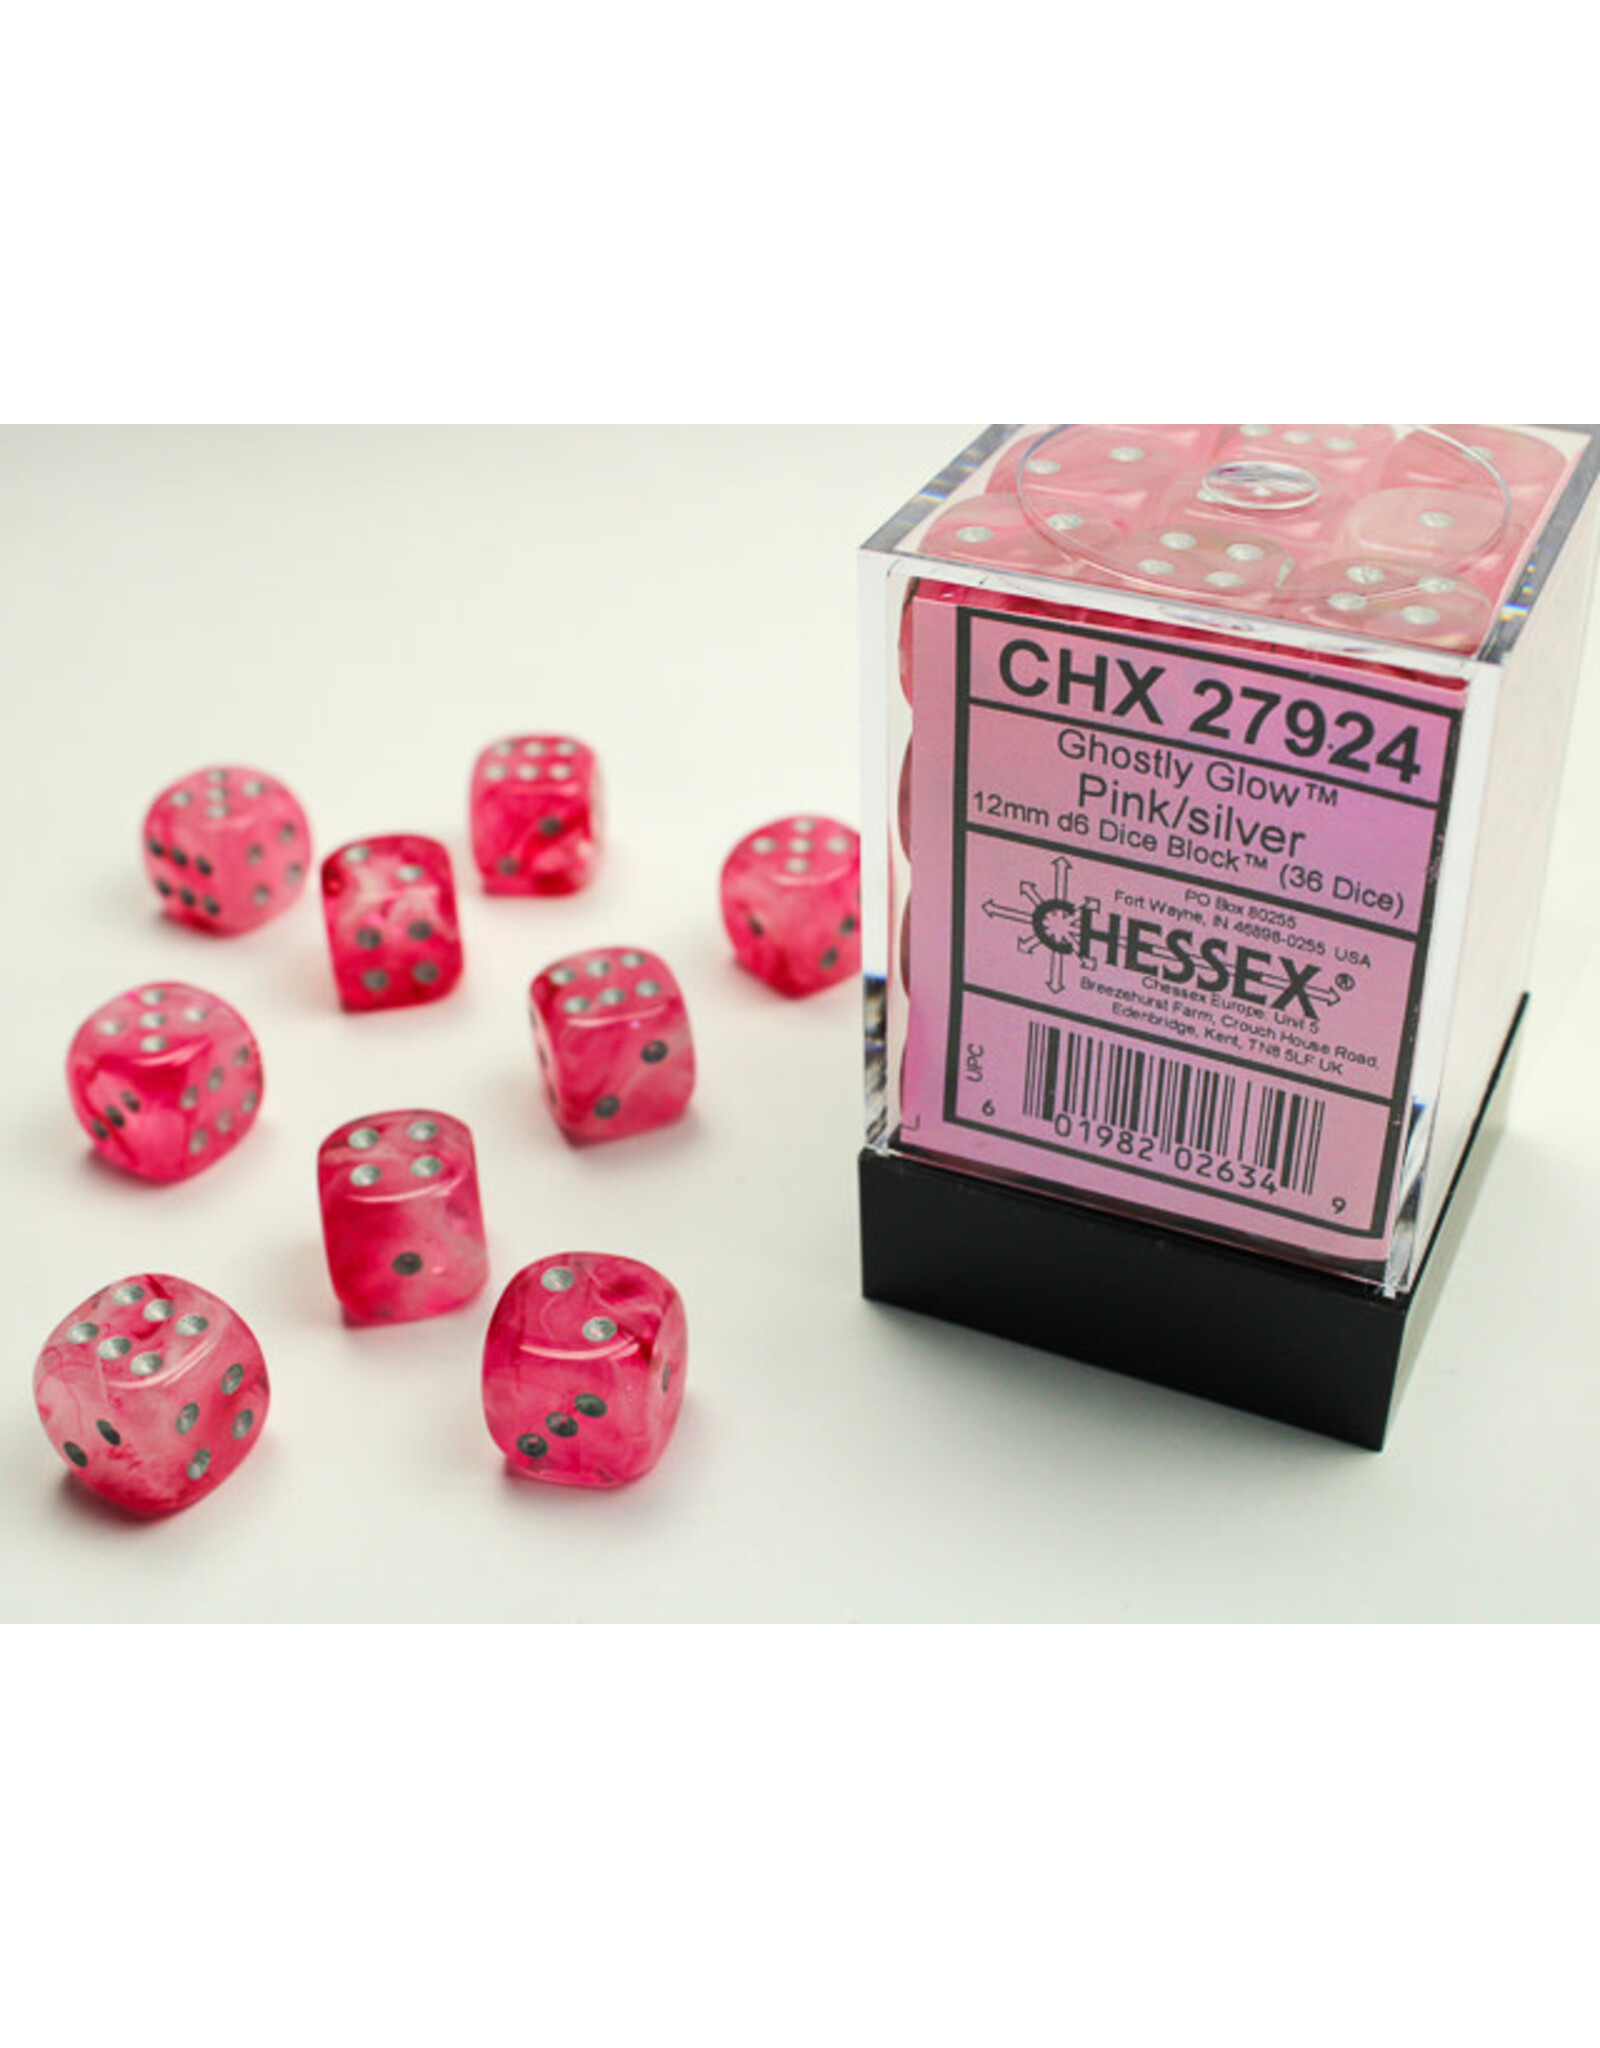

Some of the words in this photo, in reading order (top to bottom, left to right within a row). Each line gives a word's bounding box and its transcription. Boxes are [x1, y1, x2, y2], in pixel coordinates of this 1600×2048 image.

[1000, 639, 1166, 725] CHX
[1189, 679, 1422, 783] 27924
[1057, 729, 1193, 789] Ghostly
[1078, 772, 1306, 857] Pink/silver
[973, 791, 1050, 827] 12mm
[1057, 811, 1090, 835] d6
[1099, 820, 1158, 852] Dice
[1279, 862, 1324, 893] (36
[1332, 874, 1406, 919] Dice)
[1114, 890, 1145, 909] Fort
[1149, 898, 1206, 927] Wayne,
[1212, 914, 1229, 930] IN
[1334, 947, 1372, 969] USA
[1184, 889, 1211, 907] PO
[1215, 896, 1245, 915] Box
[1247, 905, 1297, 930] 80255
[1080, 976, 1169, 1011] Breezehurst
[1172, 1001, 1216, 1026] Farm,
[1221, 1014, 1276, 1040] Crouch
[1280, 1032, 1331, 1055] House
[1112, 1002, 1198, 1038] Edenbridge,
[1204, 1027, 1242, 1049] Kent,
[1248, 1038, 1281, 1058] TN8
[1319, 1058, 1344, 1075] UK
[1142, 975, 1207, 1003] Chessex
[1274, 1010, 1305, 1030] Unit
[1309, 1019, 1320, 1035] 5
[966, 1043, 984, 1083] UPC
[981, 1100, 996, 1117] 6
[1054, 1113, 1154, 1163] 01982
[1174, 1147, 1277, 1195] 02634
[1331, 1196, 1347, 1215] 9
